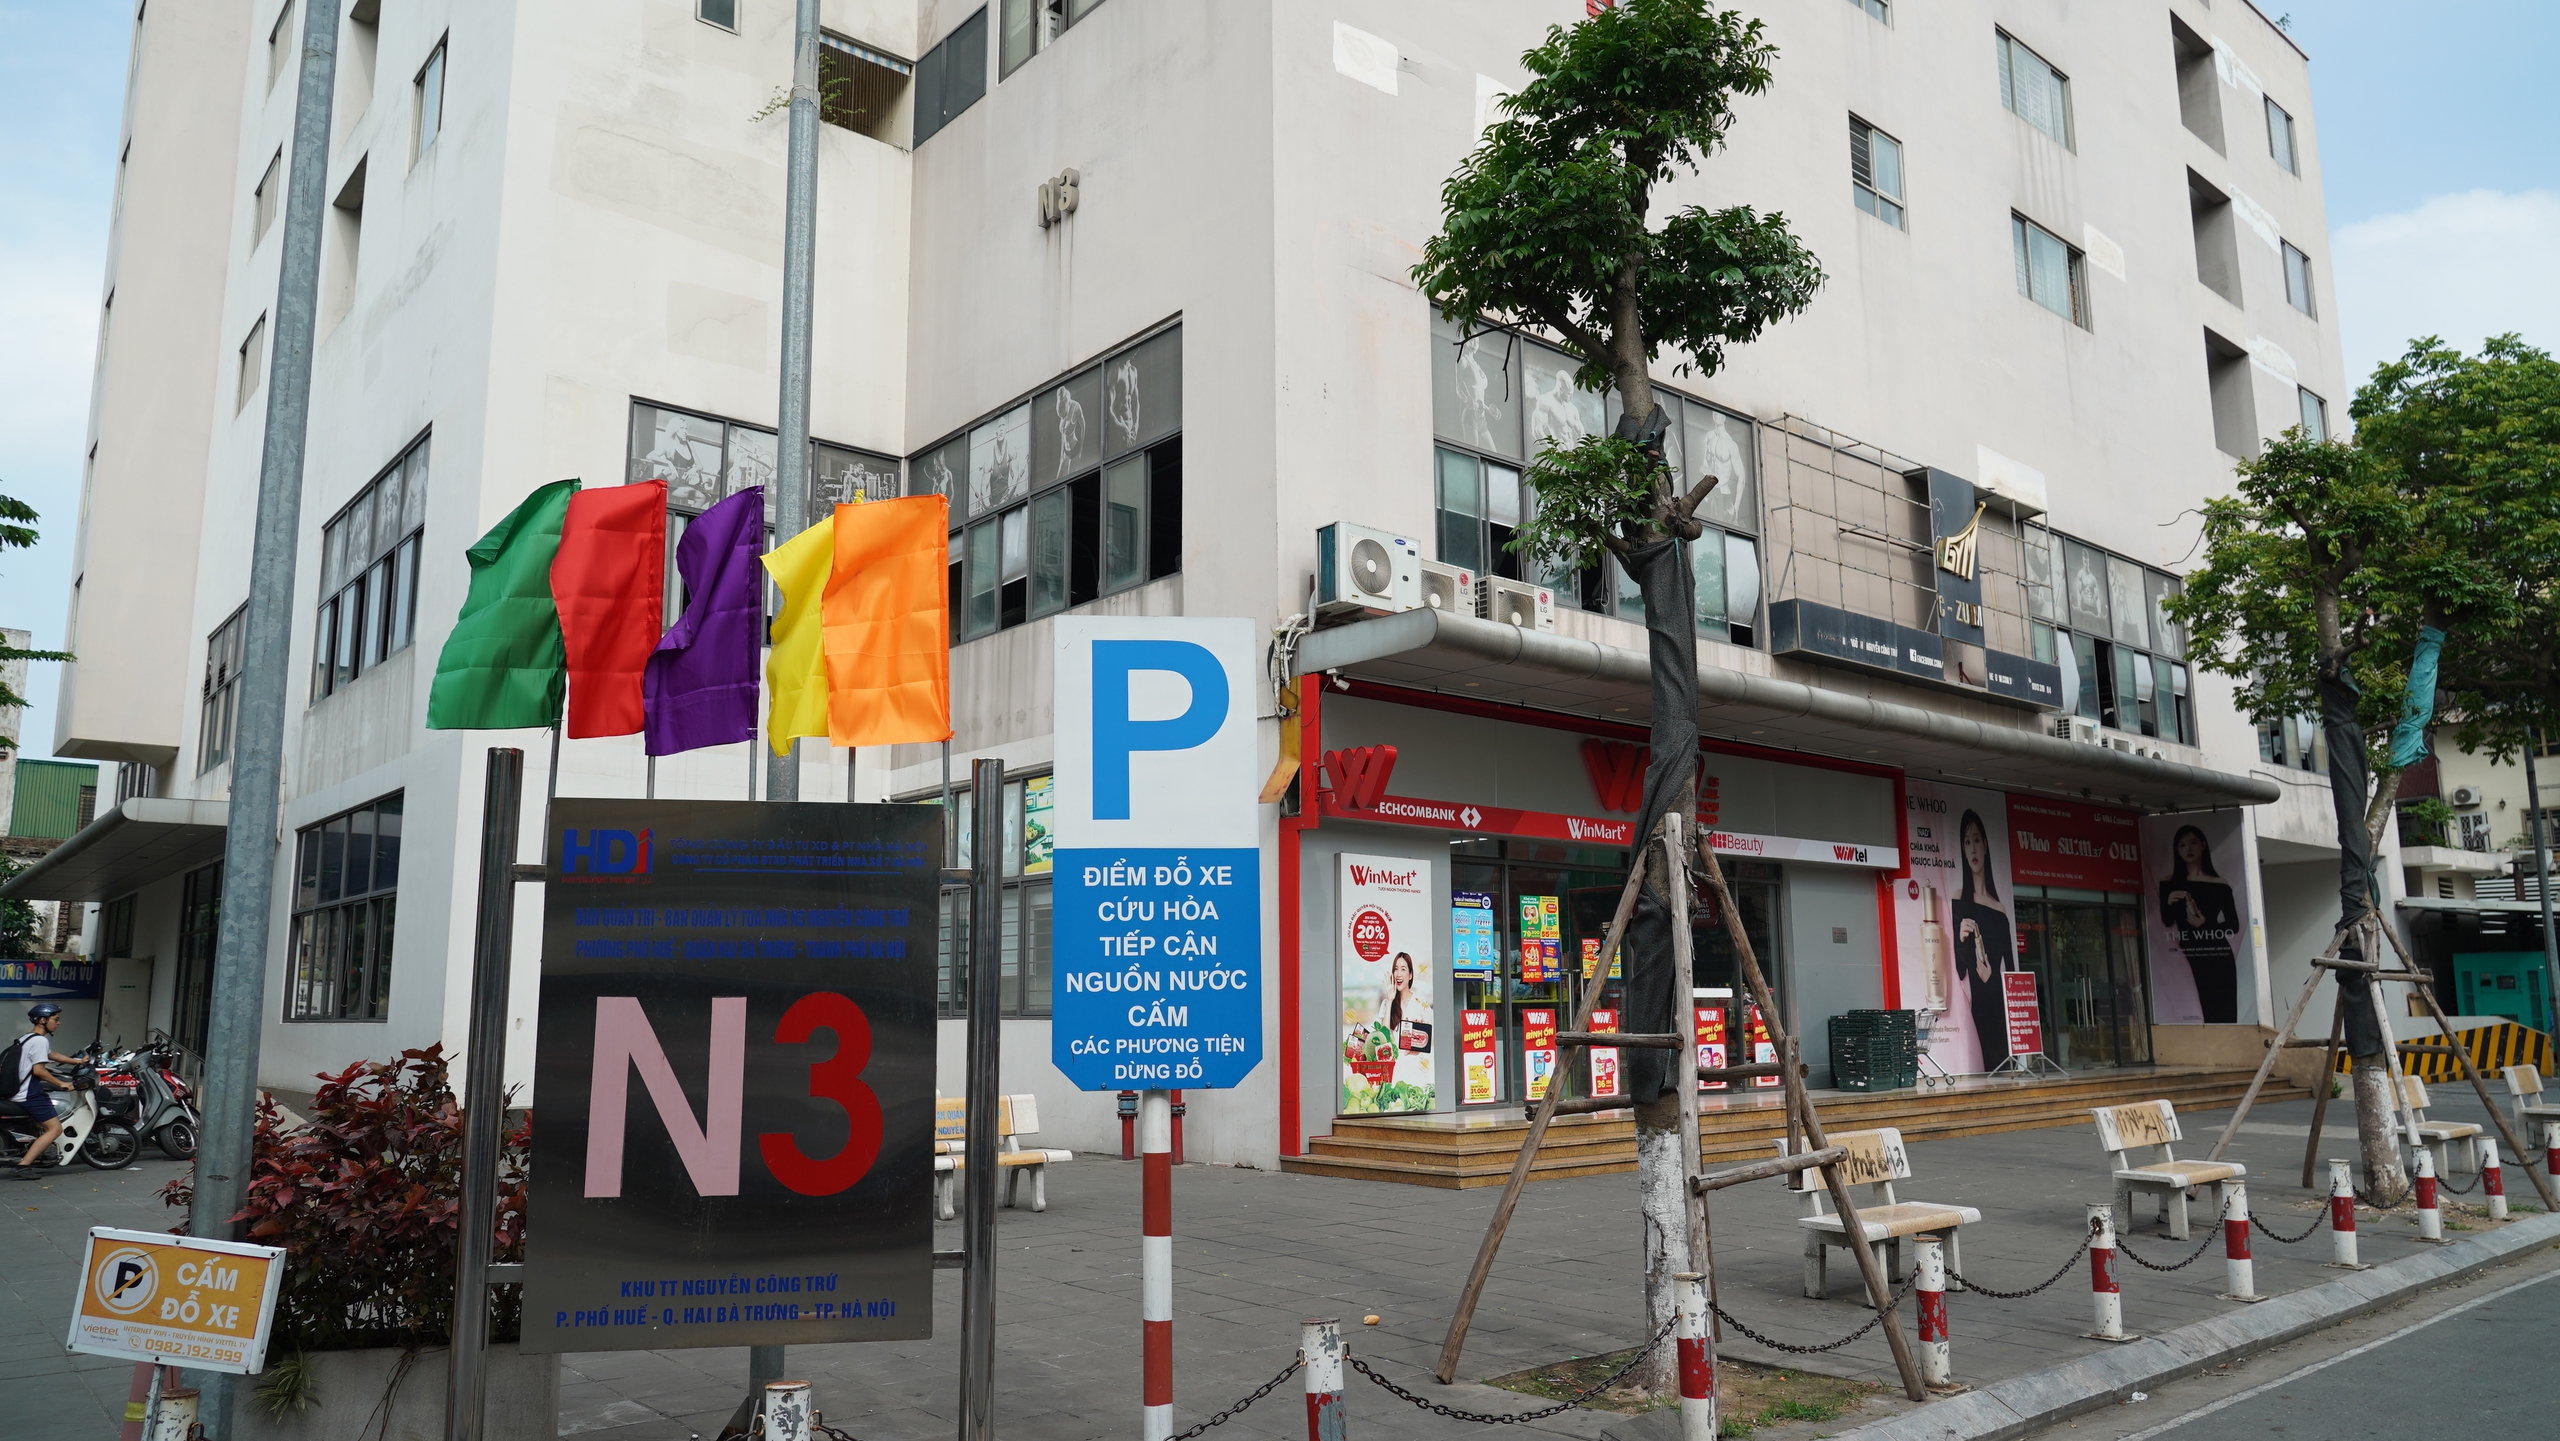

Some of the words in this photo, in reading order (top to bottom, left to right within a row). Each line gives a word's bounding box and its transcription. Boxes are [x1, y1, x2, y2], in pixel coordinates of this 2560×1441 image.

[1037, 167, 1081, 229] N3
[1092, 640, 1229, 820] P
[1375, 801, 1456, 821] ECHCOMBANK
[1917, 797, 1947, 814] WHOO
[709, 838, 748, 850] CÔNG
[751, 841, 763, 850] TY
[766, 837, 793, 850] ĐẦU
[812, 842, 829, 851] XD
[842, 842, 855, 851] PT
[1727, 834, 1764, 856] Beauty
[1910, 841, 1924, 852] CHÌA
[2017, 830, 2050, 852] Whoo
[671, 853, 699, 865] CÔNG
[701, 855, 713, 865] TY
[789, 854, 814, 867] PHÁT
[817, 852, 845, 868] TRIỂN
[847, 854, 867, 868] NHÀ
[885, 857, 891, 867] 7
[1083, 857, 1149, 887] ĐIỂM
[1154, 856, 1192, 887] ĐỖ
[1200, 866, 1232, 886] XE
[1911, 856, 1931, 869] NGƯỢC
[576, 908, 599, 926] BAN
[602, 902, 634, 928] QUẢN
[637, 909, 655, 931] TRỊ
[665, 909, 688, 927] BAN
[691, 902, 722, 929] QUẢN
[725, 905, 738, 927] LÝ
[741, 904, 762, 927] TOÀ
[765, 904, 788, 927] NHÀ
[808, 902, 853, 927] NGUYỄN
[855, 905, 886, 928] CÔNG
[1098, 895, 1155, 922] CỨU
[1163, 895, 1219, 921] HỎA
[1099, 929, 1156, 957] TIẾP
[1163, 930, 1217, 961] CẬN
[1357, 925, 1385, 940] 20%
[2164, 930, 2189, 941] THE
[2192, 928, 2234, 941] WHOO
[576, 936, 624, 958] PHƯỜNG
[626, 934, 650, 958] PHỐ
[653, 935, 676, 958] HUẾ
[684, 937, 716, 963] QUẬN
[718, 940, 738, 959] HAI
[740, 937, 755, 959] BÀ
[759, 939, 795, 959] TRƯNG
[806, 936, 842, 959] THÀNH
[844, 934, 867, 959] PHỐ
[868, 936, 885, 959] HÀ
[886, 936, 906, 962] NỘI
[51, 966, 76, 984] DỊCH
[80, 966, 93, 984] VỤ
[1066, 963, 1161, 993] NGUỒN
[1169, 963, 1248, 991] NƯỚC
[1127, 997, 1188, 1028] CẤM
[1070, 1031, 1110, 1055] CÁC
[1116, 1036, 1199, 1054] PHƯƠNG
[1204, 1034, 1245, 1055] TIỆN
[1114, 1058, 1170, 1080] DỪNG
[1174, 1056, 1203, 1079] ĐỖ
[584, 991, 883, 1198] N3
[938, 1122, 965, 1135] NGUYỄN
[177, 1256, 239, 1292] CẤM
[621, 1280, 656, 1298] KHU
[660, 1279, 678, 1296] TT
[682, 1272, 751, 1296] NGUYỄN
[755, 1274, 801, 1294] CÔNG
[805, 1272, 838, 1293] TRỨ
[161, 1290, 200, 1324] ĐỖ
[206, 1303, 239, 1330] XE
[556, 1311, 570, 1328] P.
[574, 1303, 609, 1327] PHỐ
[613, 1304, 648, 1326] HUẾ
[662, 1308, 679, 1326] Q.
[683, 1306, 713, 1325] HAI
[716, 1302, 740, 1323] BÀ
[744, 1303, 799, 1323] TRƯNG
[814, 1303, 837, 1321] TP.
[841, 1299, 863, 1319] HÀ
[867, 1298, 896, 1321] NỘI
[83, 1323, 119, 1337] viettel
[123, 1325, 152, 1335] INTERNET
[154, 1328, 167, 1337] WIFI
[172, 1331, 196, 1342] TRUYỀN
[197, 1334, 214, 1344] HÌNH
[215, 1338, 238, 1348] VIETTEL
[239, 1341, 248, 1349] TV
[145, 1337, 243, 1363] 0982.192.999
